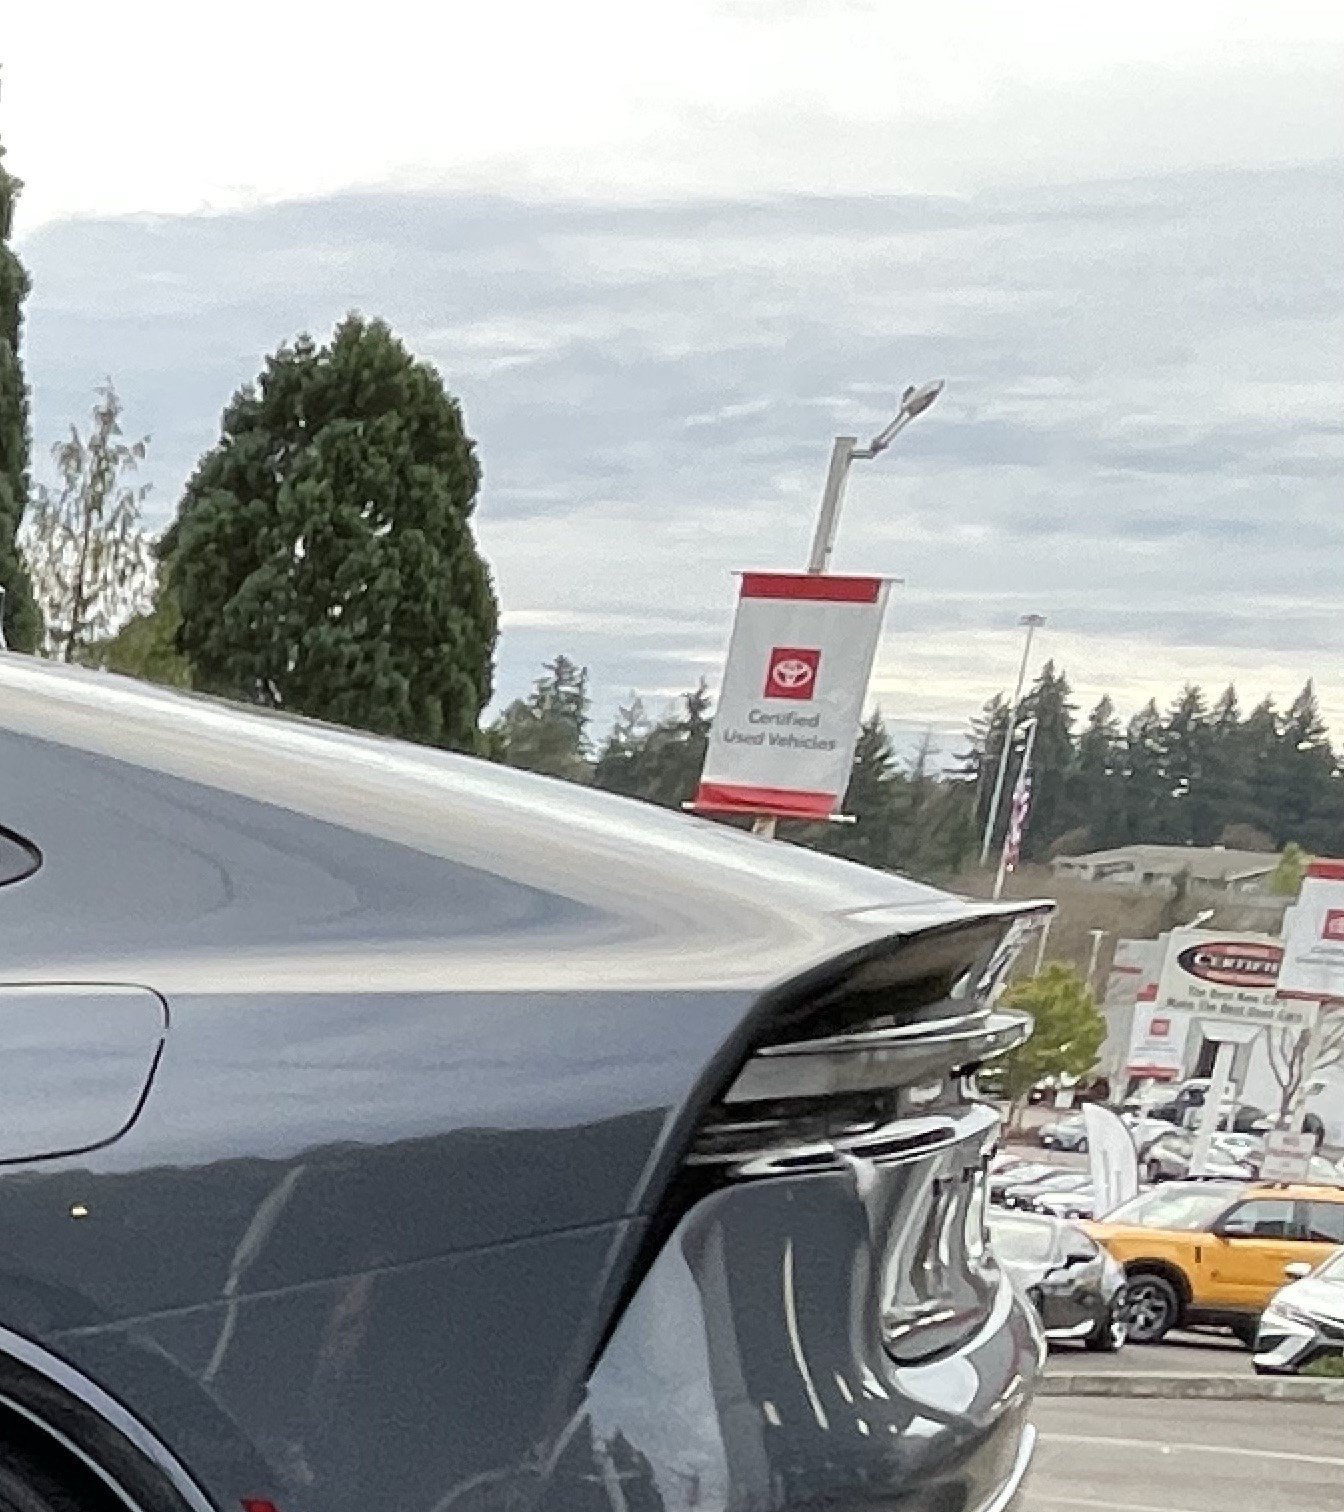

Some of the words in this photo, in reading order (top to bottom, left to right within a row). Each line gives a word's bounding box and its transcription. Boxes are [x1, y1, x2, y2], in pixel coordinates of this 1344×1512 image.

[748, 708, 820, 728] Certified
[723, 728, 765, 746] Used
[768, 732, 837, 751] Vehicles
